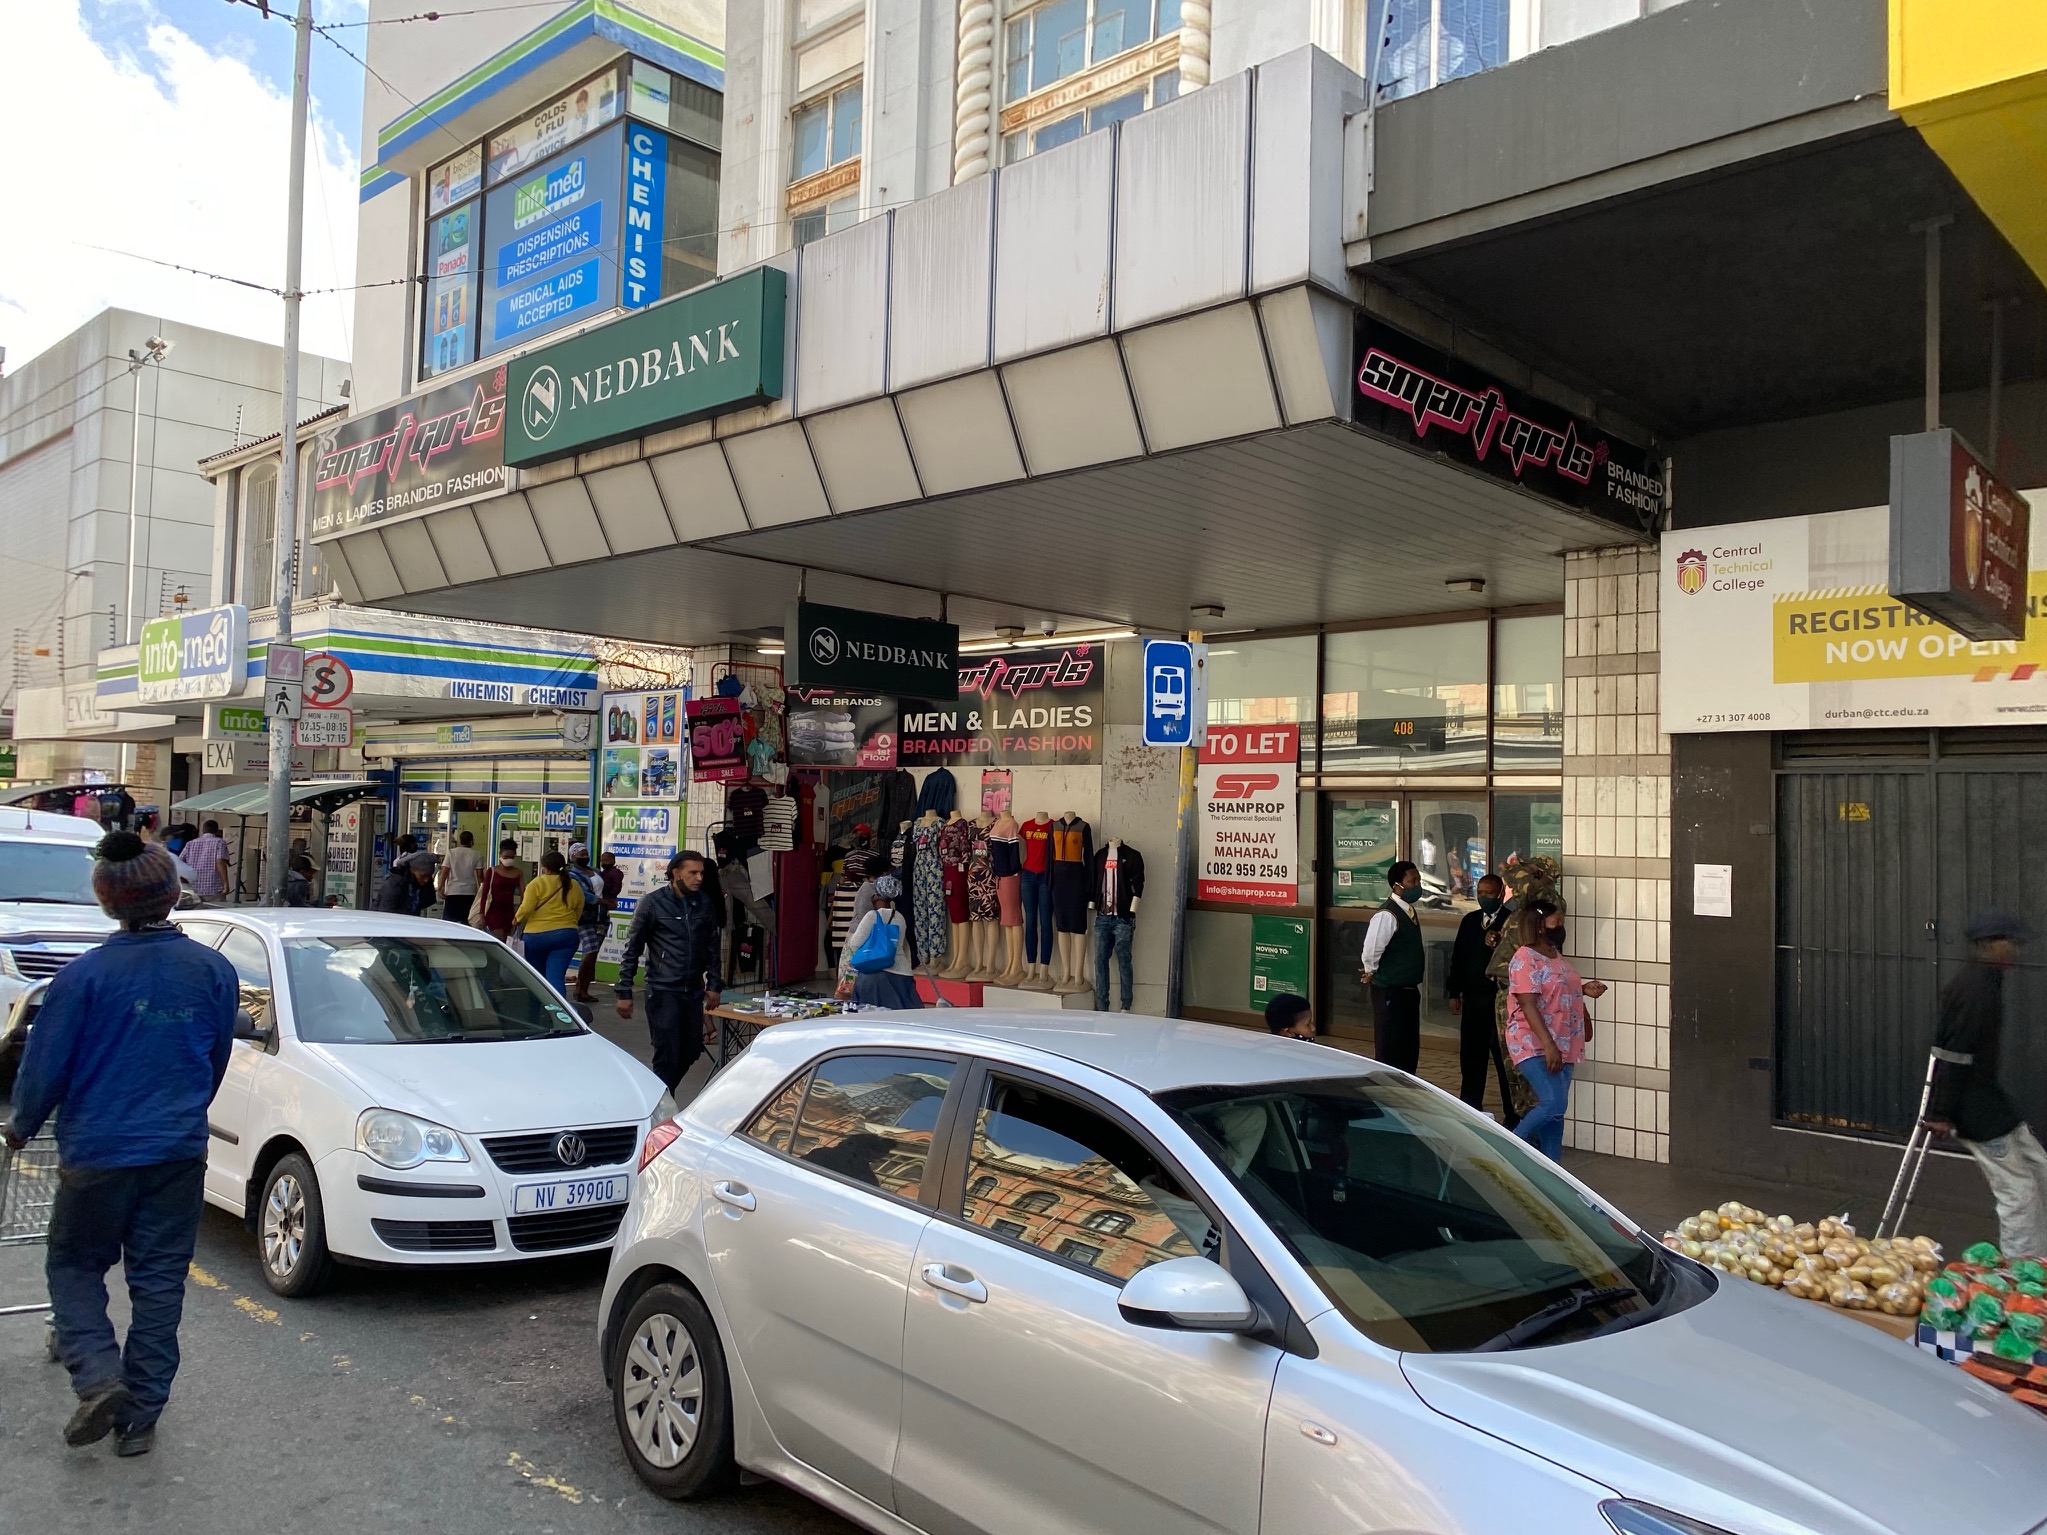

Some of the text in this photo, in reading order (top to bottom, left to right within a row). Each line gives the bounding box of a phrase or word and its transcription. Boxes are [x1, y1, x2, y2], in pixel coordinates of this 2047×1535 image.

[534, 102, 567, 128] COLDS
[536, 130, 543, 140] &
[545, 116, 565, 135] FLU
[517, 160, 583, 217] info-med
[628, 134, 653, 303] CHEMIST
[517, 216, 580, 257] DISPENSING
[439, 253, 467, 276] Panado
[507, 231, 590, 280] PRESCRIPTIONS
[510, 270, 583, 312] MEDICAL AIDS
[517, 296, 573, 329] ACCEPTED
[570, 320, 740, 410] NEDBANK
[1357, 347, 1599, 485] smart girls
[315, 384, 506, 496] smart girls
[1608, 460, 1663, 497] BRANDED
[313, 465, 505, 532] MEN & LADIES BRANDED FASHION
[1608, 481, 1659, 515] FASHION
[1713, 543, 1762, 560] Central
[1712, 559, 1773, 576] Technical
[1713, 577, 1765, 594] College
[145, 617, 228, 674] info-med
[846, 641, 950, 670] NEDBANK
[1826, 634, 2018, 664] NOW OPEN
[311, 667, 336, 695] S
[1001, 651, 1095, 700] girls
[451, 681, 588, 706] IKHEMISI CHEMIST
[811, 698, 882, 707] BIG BRANDS
[67, 695, 109, 723] EXAC
[224, 711, 270, 728] info-
[903, 705, 1093, 733] MEN & LADIES
[1696, 713, 1771, 725] +27 31 307 4008
[1825, 707, 1930, 719] durban@ctc.edu.za
[299, 722, 348, 731] 07:15-08:15
[1393, 720, 1414, 736] 408
[301, 734, 346, 743] 16:15-17:15
[903, 735, 1093, 754] BRANDED FASHION
[1207, 732, 1290, 755] TO LET
[863, 753, 891, 762] Floor
[876, 748, 891, 756] 1st
[721, 769, 734, 777] SALE
[1212, 773, 1280, 799] SP
[520, 805, 574, 826] info-med
[1207, 802, 1285, 814] SHANPROP
[1254, 815, 1282, 823] Specialist
[614, 809, 668, 832] info-med
[613, 834, 667, 843] PHARMACY
[1216, 831, 1276, 844] SHANJAY
[328, 847, 357, 860] SURGERY
[608, 846, 671, 857] MEDICAL AIDS ACCEPTED
[1214, 846, 1279, 859] MAHARAJ
[1213, 862, 1288, 879] 082 959 2549
[1206, 885, 1288, 899] info@shanprop.co.za
[1255, 946, 1279, 954] MOVING
[535, 1180, 614, 1209] NV 39900
